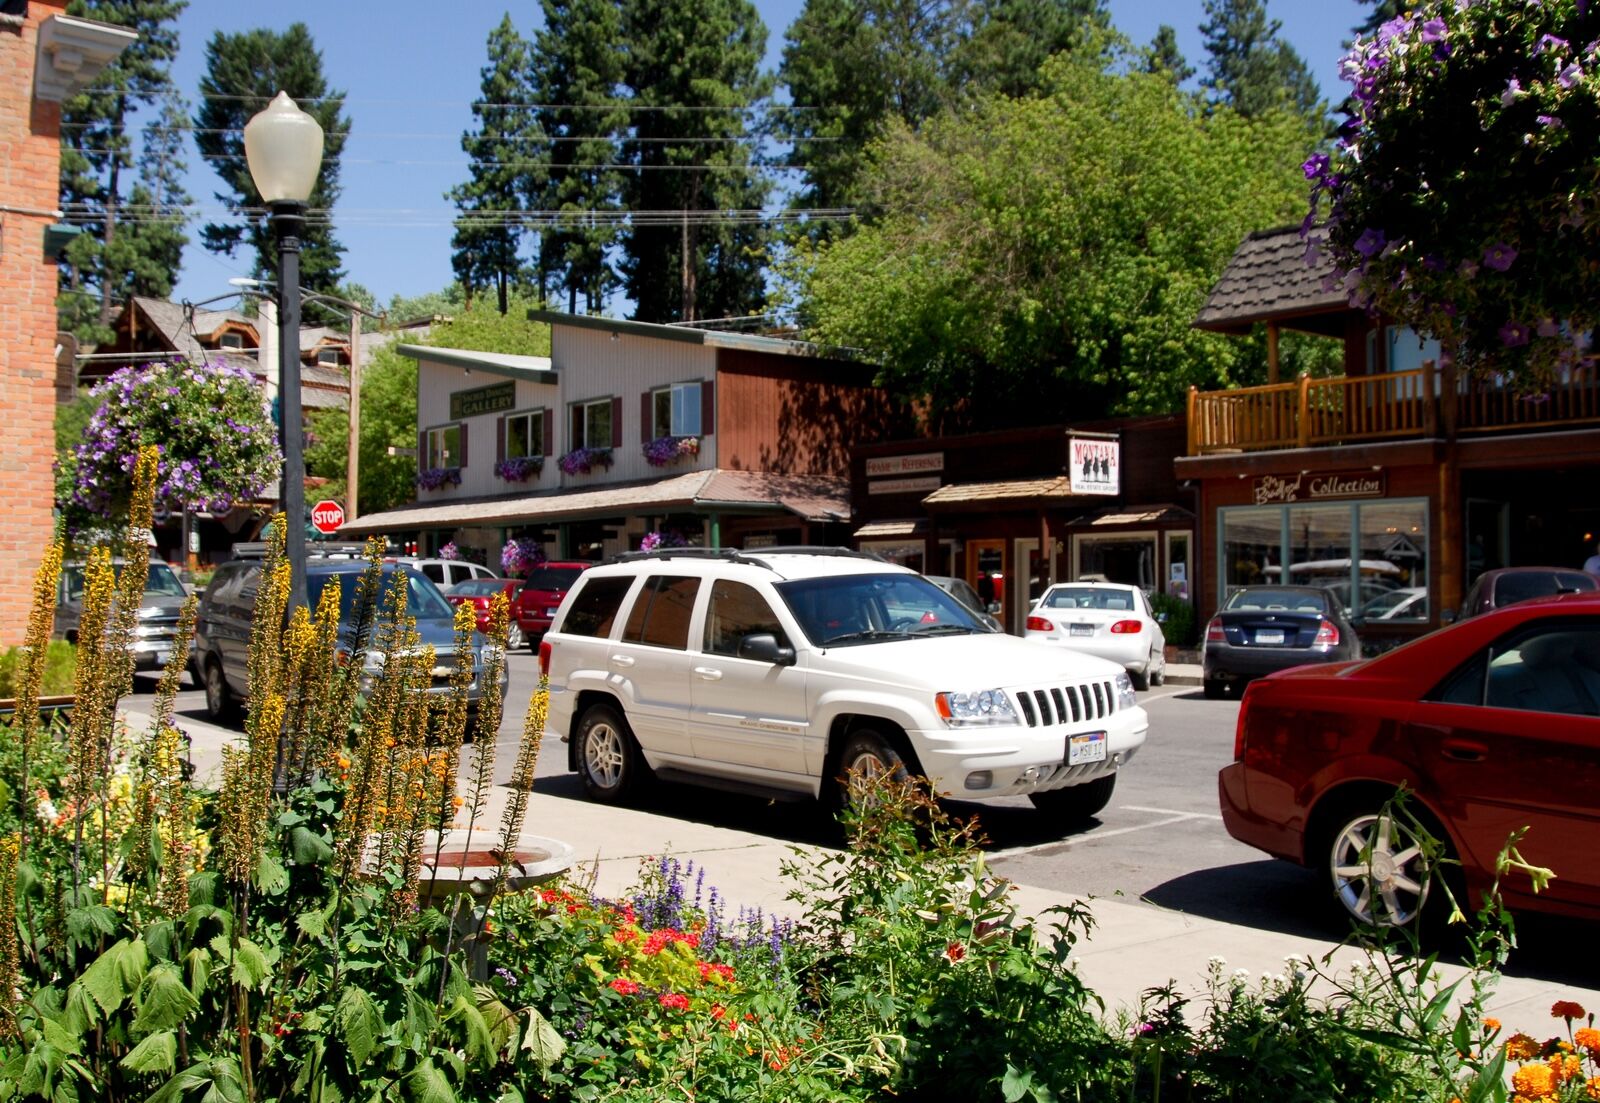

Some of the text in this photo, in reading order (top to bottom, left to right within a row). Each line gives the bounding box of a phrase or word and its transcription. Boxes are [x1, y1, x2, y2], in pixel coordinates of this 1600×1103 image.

[463, 397, 512, 413] GALLERY
[1075, 444, 1115, 466] MONTANA
[867, 461, 890, 473] FRAME
[902, 457, 941, 470] REFERENCE
[1310, 477, 1379, 494] Collection
[314, 511, 341, 524] STOP
